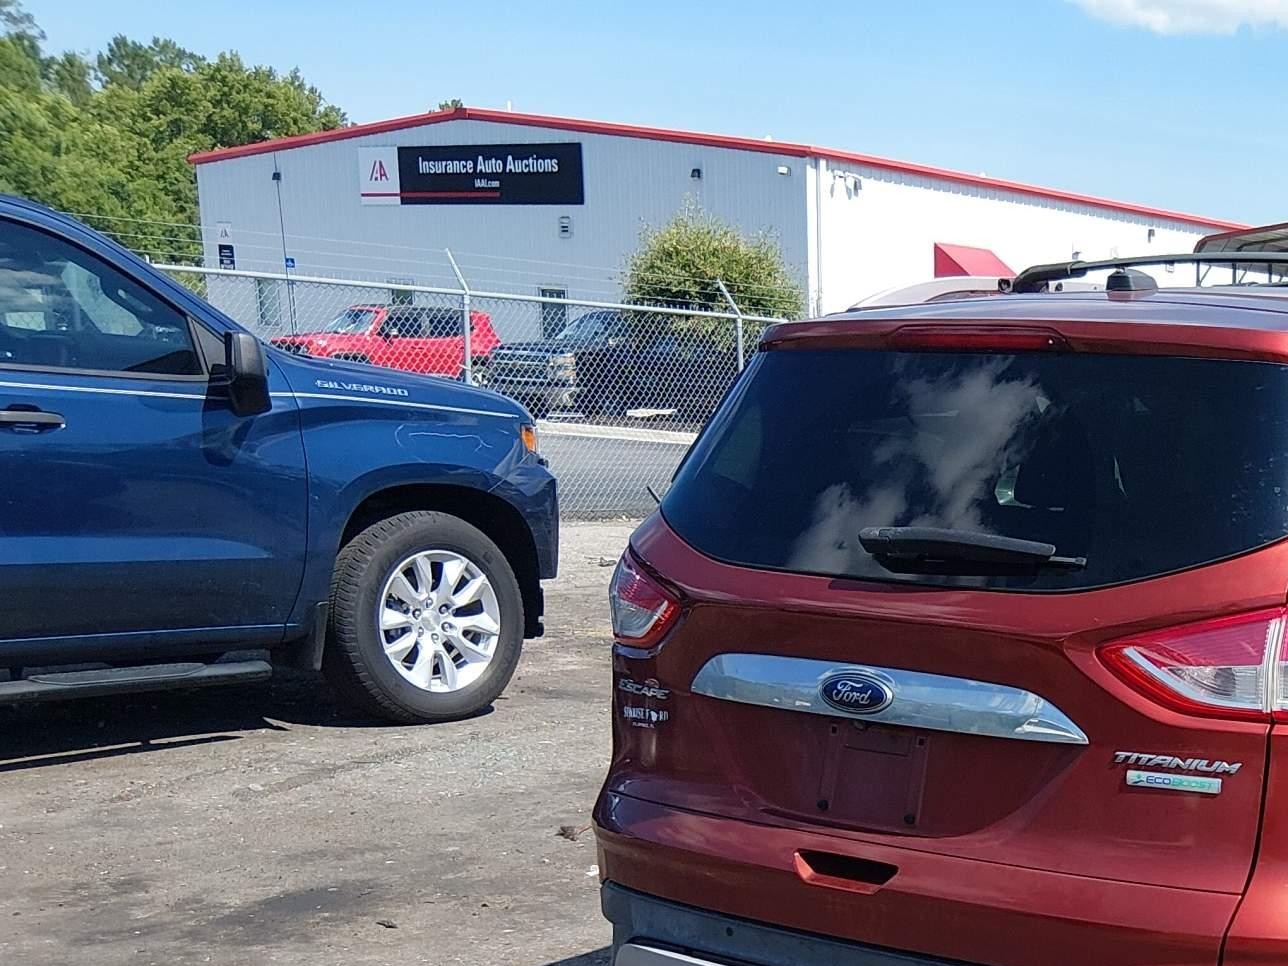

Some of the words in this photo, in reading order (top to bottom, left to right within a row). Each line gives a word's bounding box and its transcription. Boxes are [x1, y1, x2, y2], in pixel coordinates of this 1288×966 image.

[418, 156, 473, 174] Insurance
[476, 155, 503, 174] Auto
[505, 154, 559, 173] Auctions
[315, 379, 409, 397] SILVERADO
[618, 678, 670, 700] ESCAPE
[832, 680, 872, 705] Ford
[1114, 751, 1243, 775] TITANIUM
